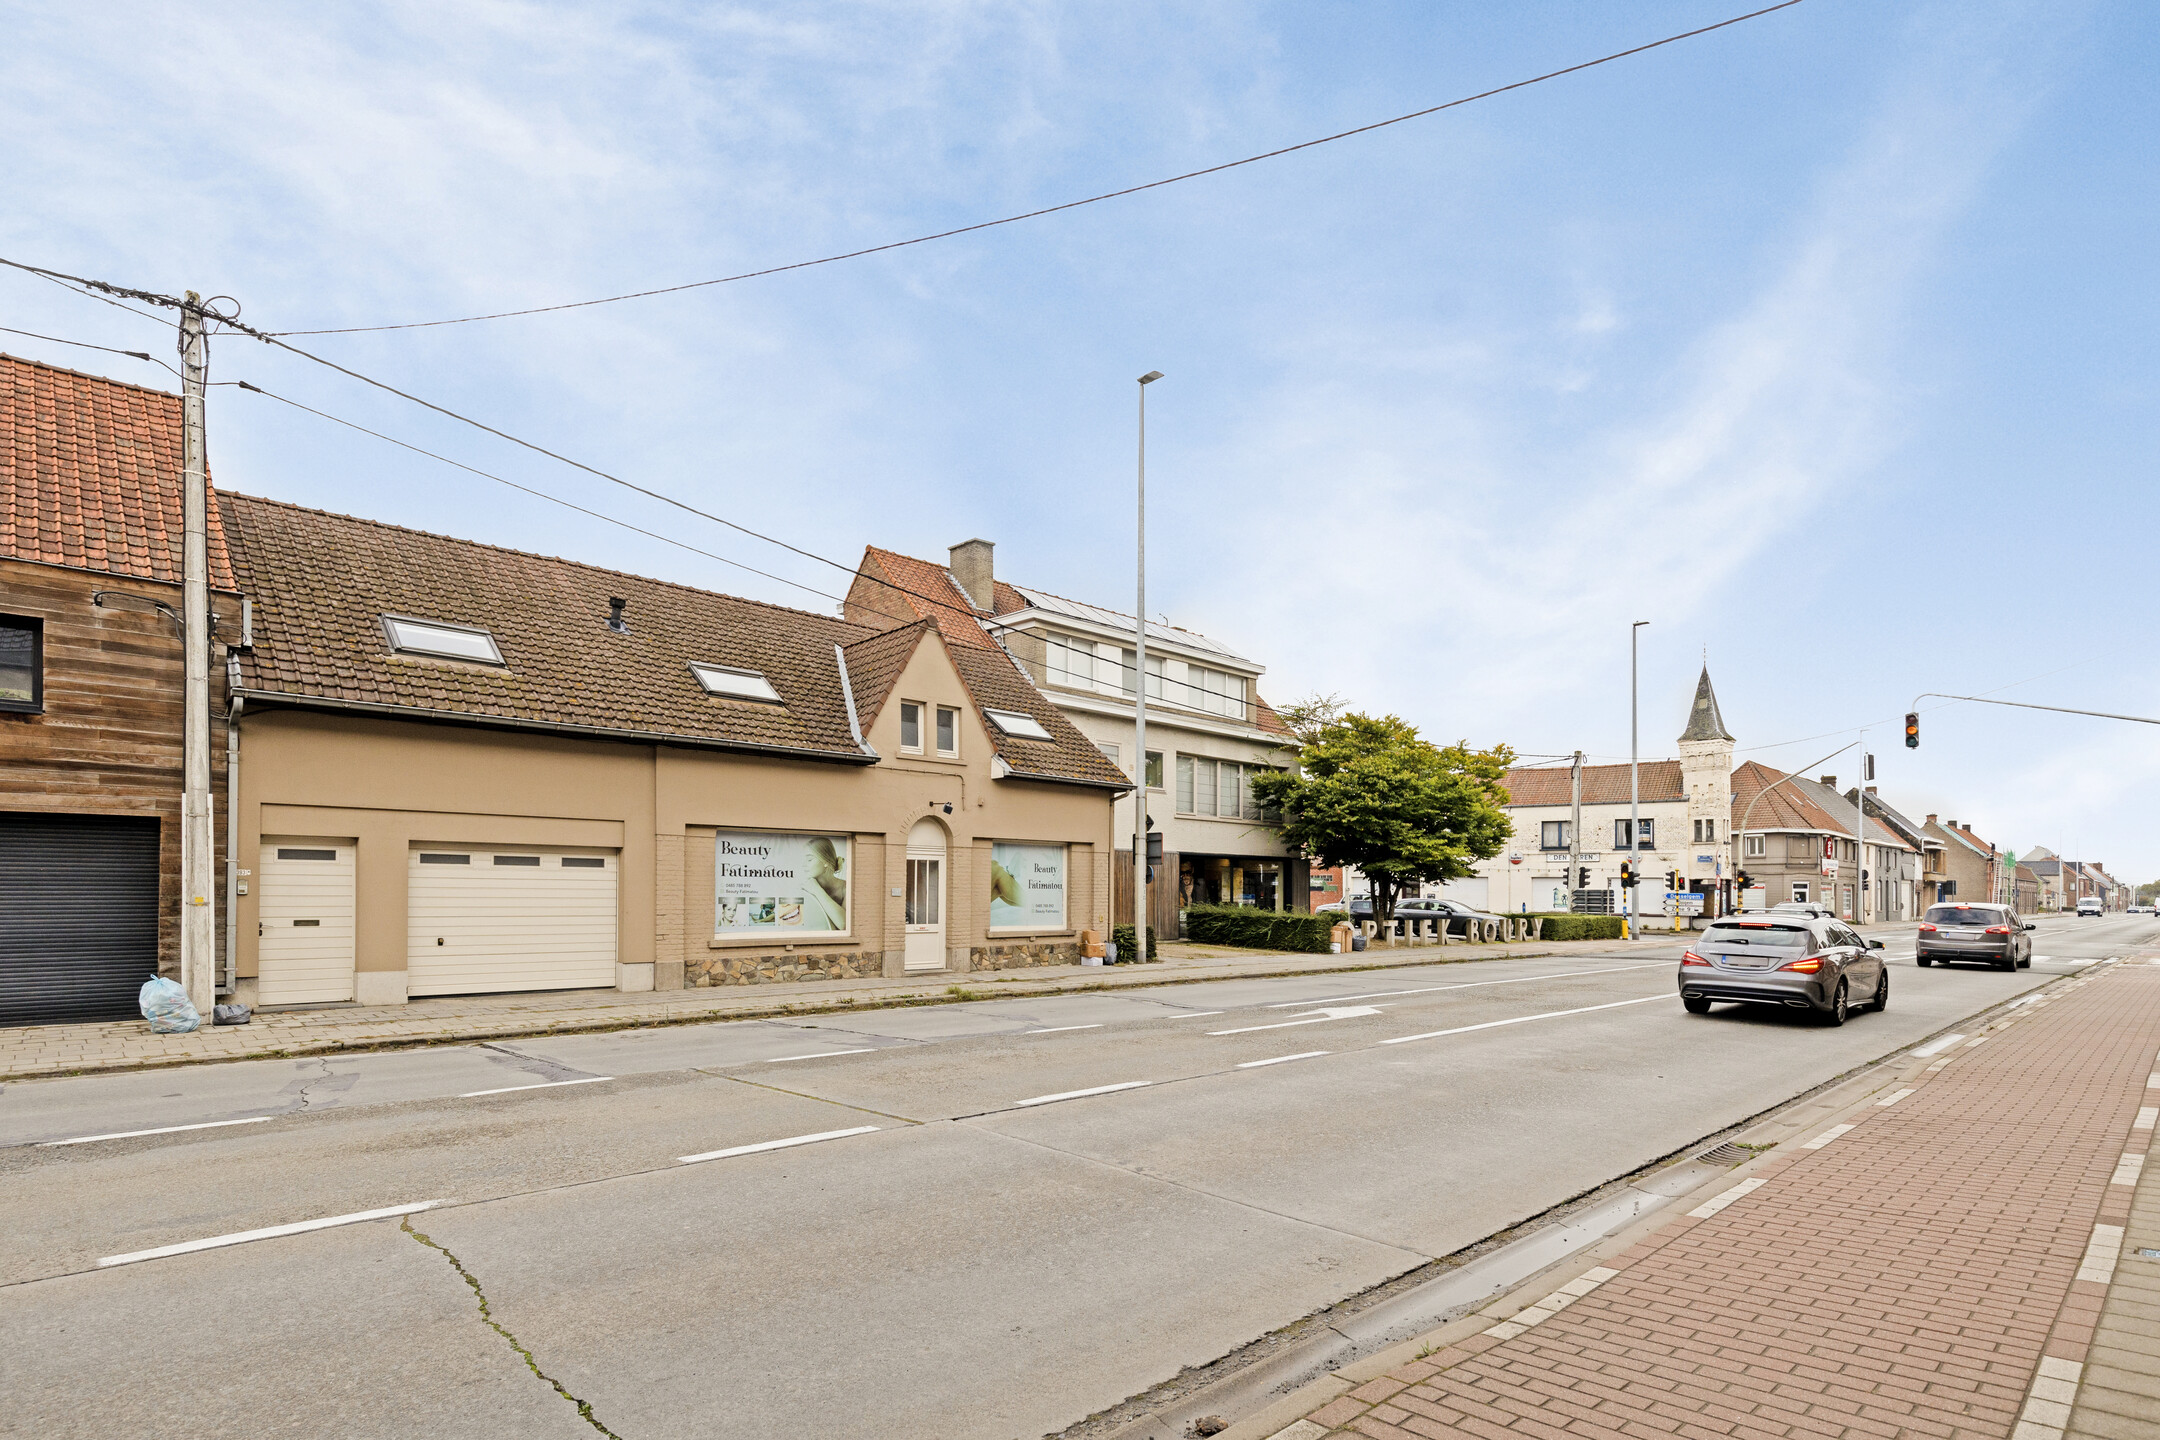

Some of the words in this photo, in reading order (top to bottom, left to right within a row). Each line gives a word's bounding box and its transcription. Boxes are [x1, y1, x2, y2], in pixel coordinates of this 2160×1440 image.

[721, 840, 771, 860] Beauty
[721, 863, 794, 878] Fatimatou
[1034, 863, 1058, 876] Beauty
[1028, 879, 1063, 890] Fatimatou
[1466, 918, 1543, 943] BOURY
